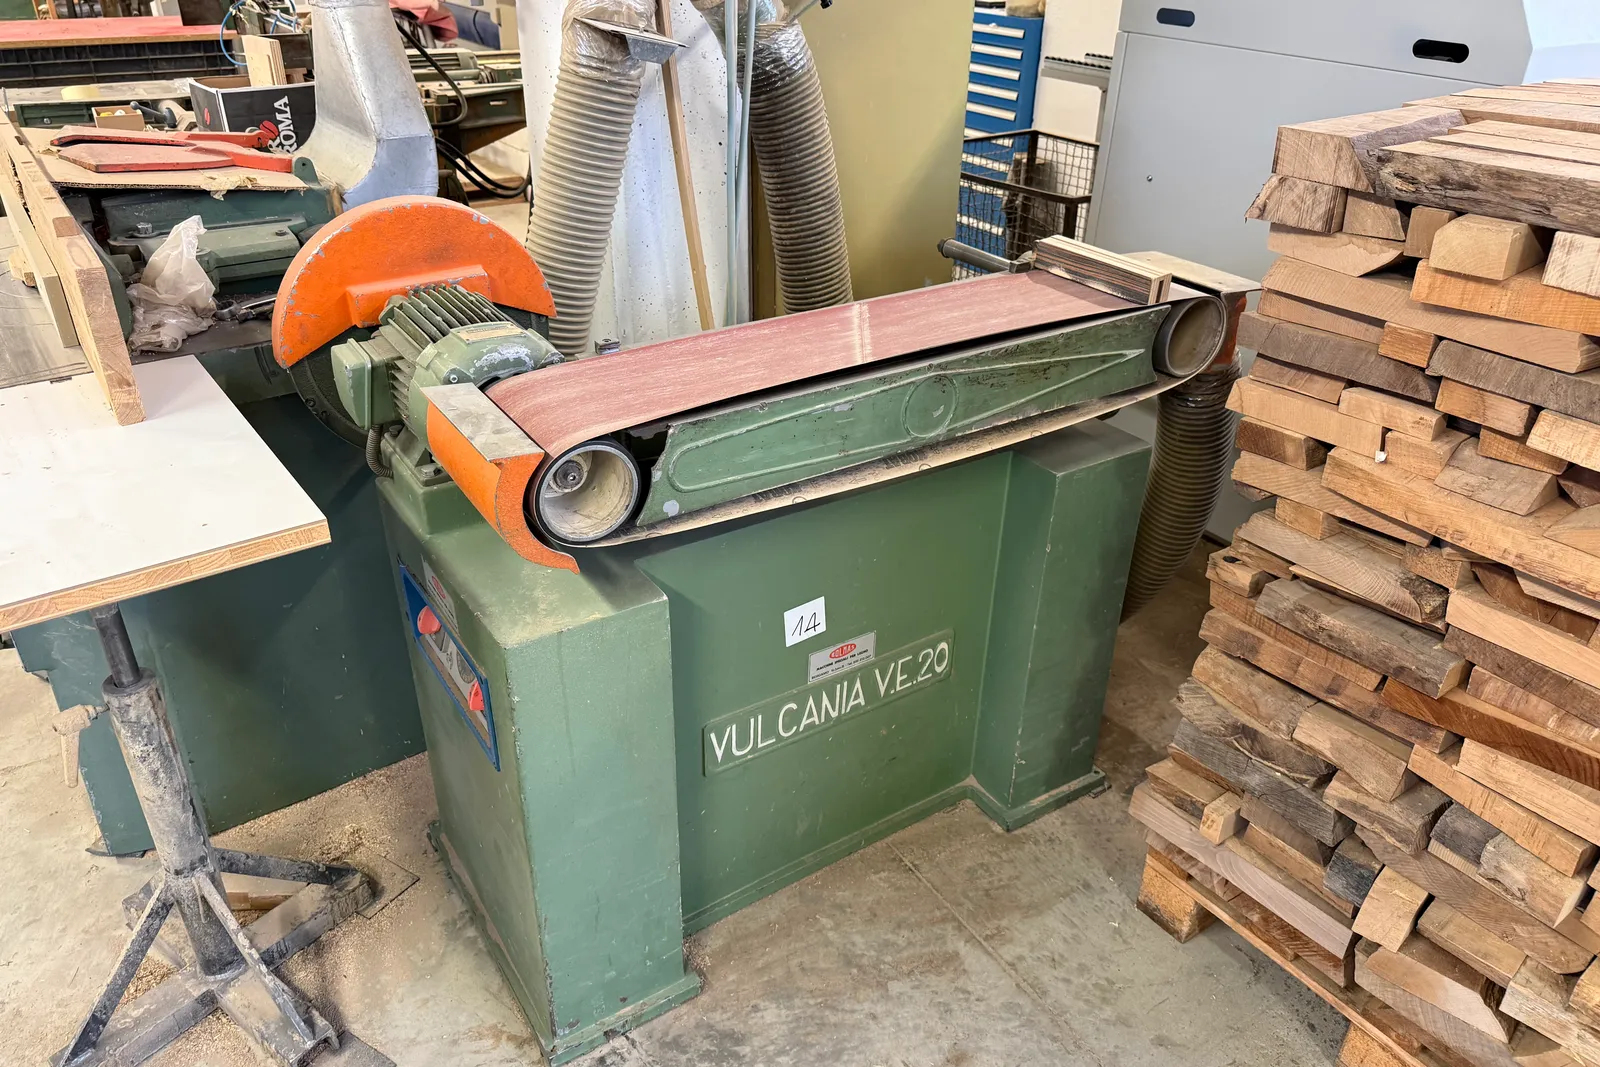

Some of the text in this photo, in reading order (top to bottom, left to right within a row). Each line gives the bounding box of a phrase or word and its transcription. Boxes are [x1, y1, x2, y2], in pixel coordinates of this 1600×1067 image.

[792, 611, 821, 637] 14
[709, 641, 949, 763] VULCANIA V.E.20
